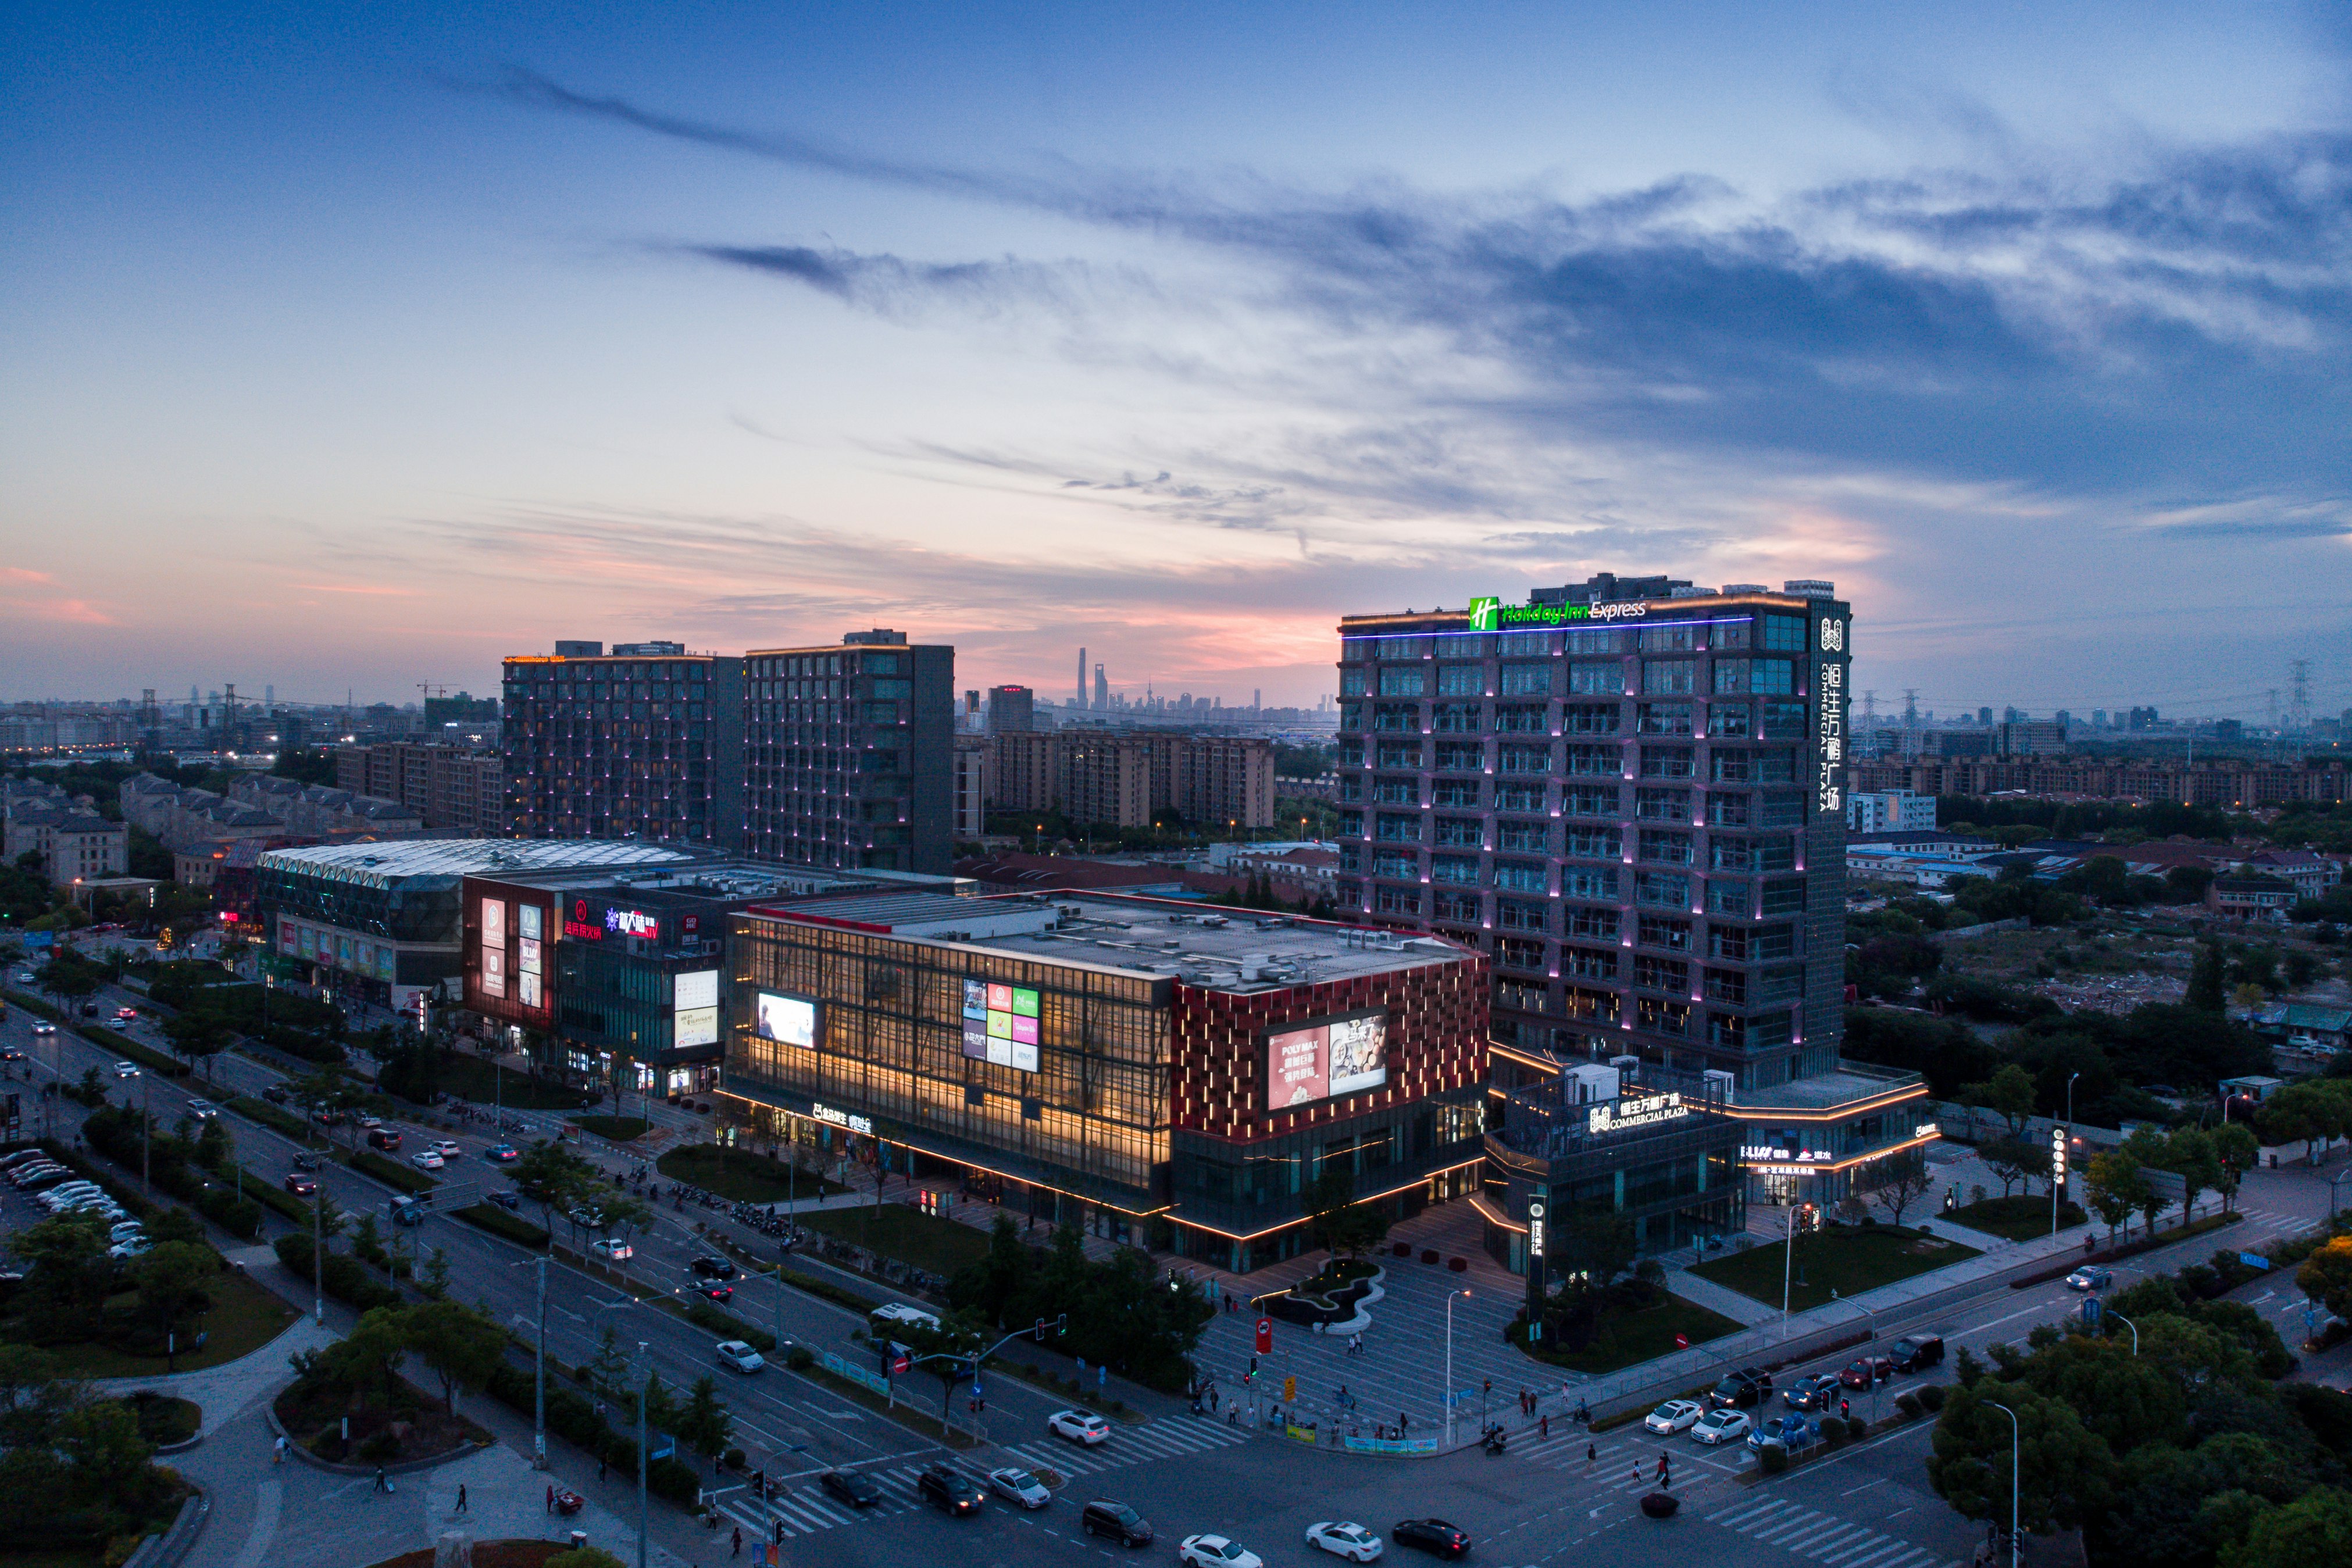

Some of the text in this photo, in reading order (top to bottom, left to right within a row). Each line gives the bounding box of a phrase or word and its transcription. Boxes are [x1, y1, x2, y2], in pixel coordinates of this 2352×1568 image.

[1502, 601, 1646, 624] Holiday Inn Express
[619, 910, 645, 933] 新大陆
[1609, 1106, 1688, 1130] COMMERCIAL PLAZA
